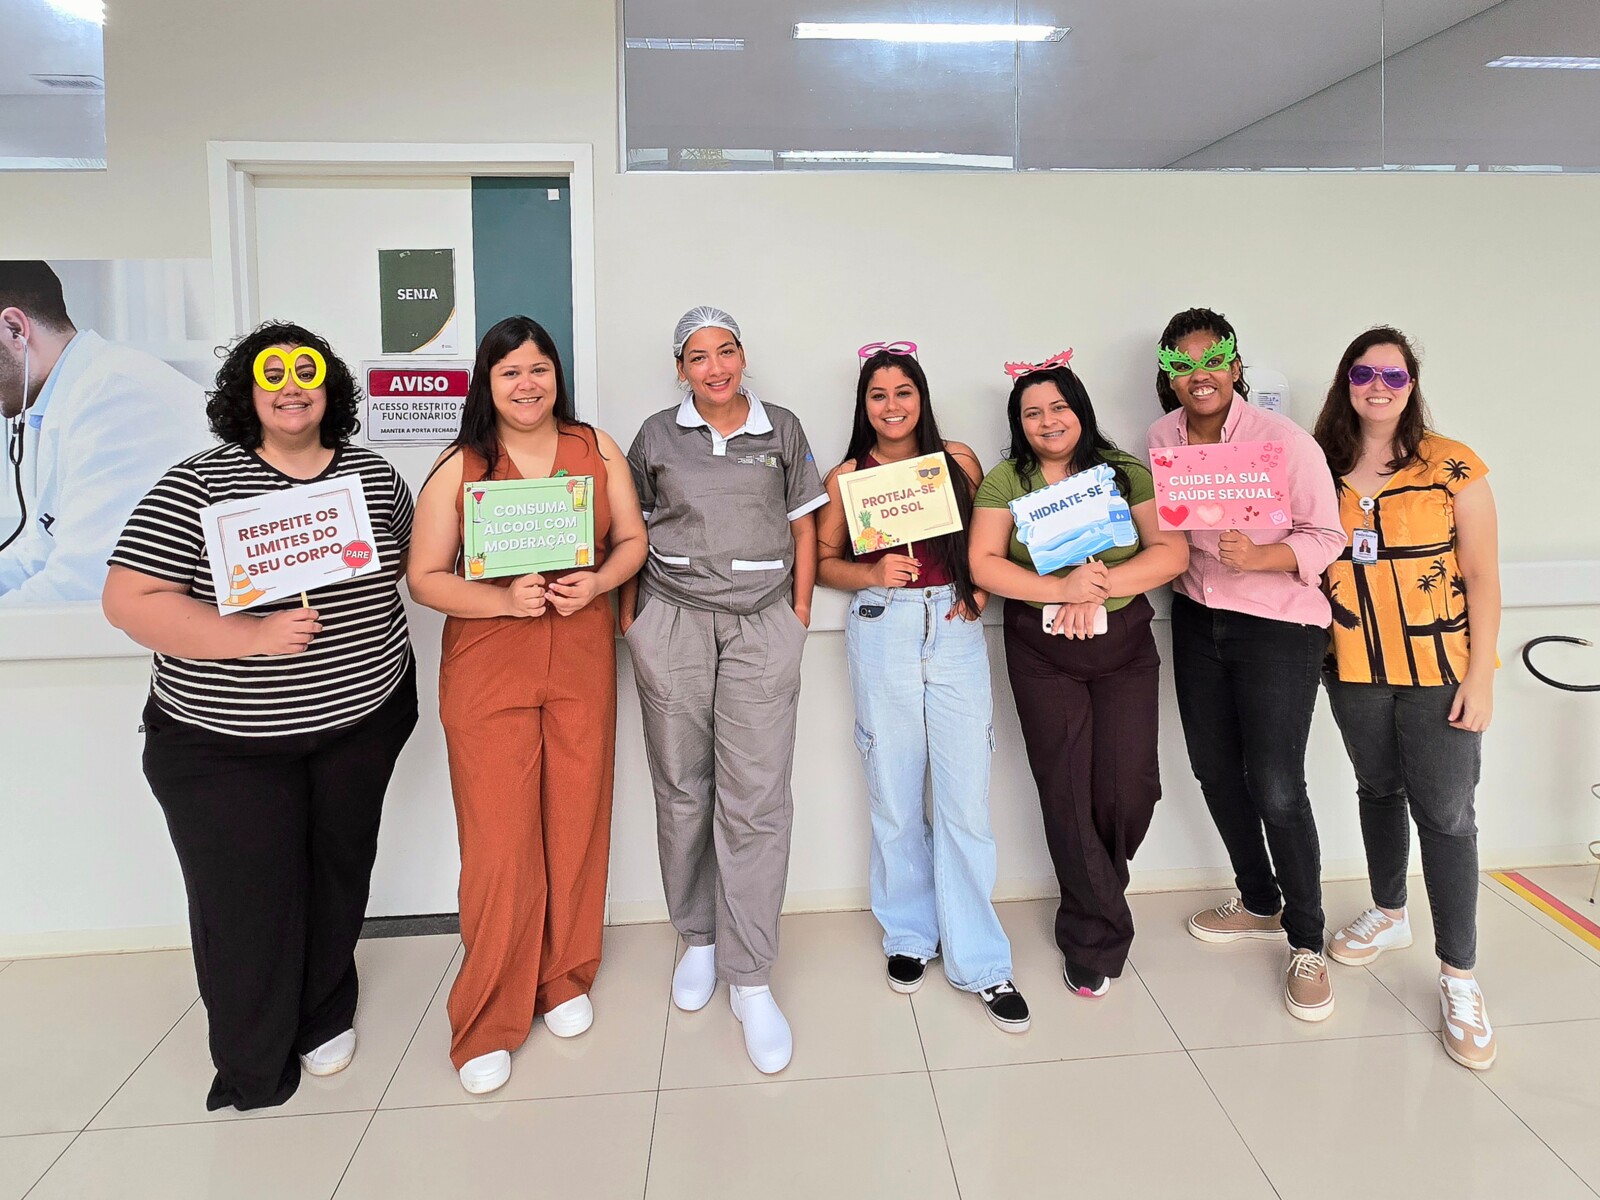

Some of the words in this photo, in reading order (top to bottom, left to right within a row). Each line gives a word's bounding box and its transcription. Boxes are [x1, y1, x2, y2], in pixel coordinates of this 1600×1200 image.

[397, 288, 438, 300] SENIA
[389, 376, 449, 392] AVISO
[372, 402, 409, 411] ACESSO
[412, 402, 457, 411] RESTRITO
[382, 411, 457, 420] FUNCIONÁRIOS
[1169, 474, 1212, 486] CUIDE
[1215, 473, 1236, 484] DA
[1239, 472, 1270, 483] SUA
[862, 483, 935, 508] PROTEJA-SE
[1029, 484, 1103, 521] HIDRATE-SE
[1168, 488, 1215, 501] SAÚDE
[1218, 488, 1276, 500] SEXUAL
[494, 501, 568, 517] CONSUMA
[880, 506, 899, 519] DO
[901, 501, 924, 514] SOL
[238, 514, 313, 541] RESPEITE
[315, 507, 338, 523] OS
[484, 520, 542, 536] ÁLCOOL
[544, 516, 577, 529] COM
[246, 532, 310, 558] LIMITES
[313, 526, 337, 542] DO
[484, 532, 577, 553] MODERAÇÃO
[247, 558, 281, 576] SEU
[284, 543, 343, 567] CORPO
[345, 550, 369, 559] PARE
